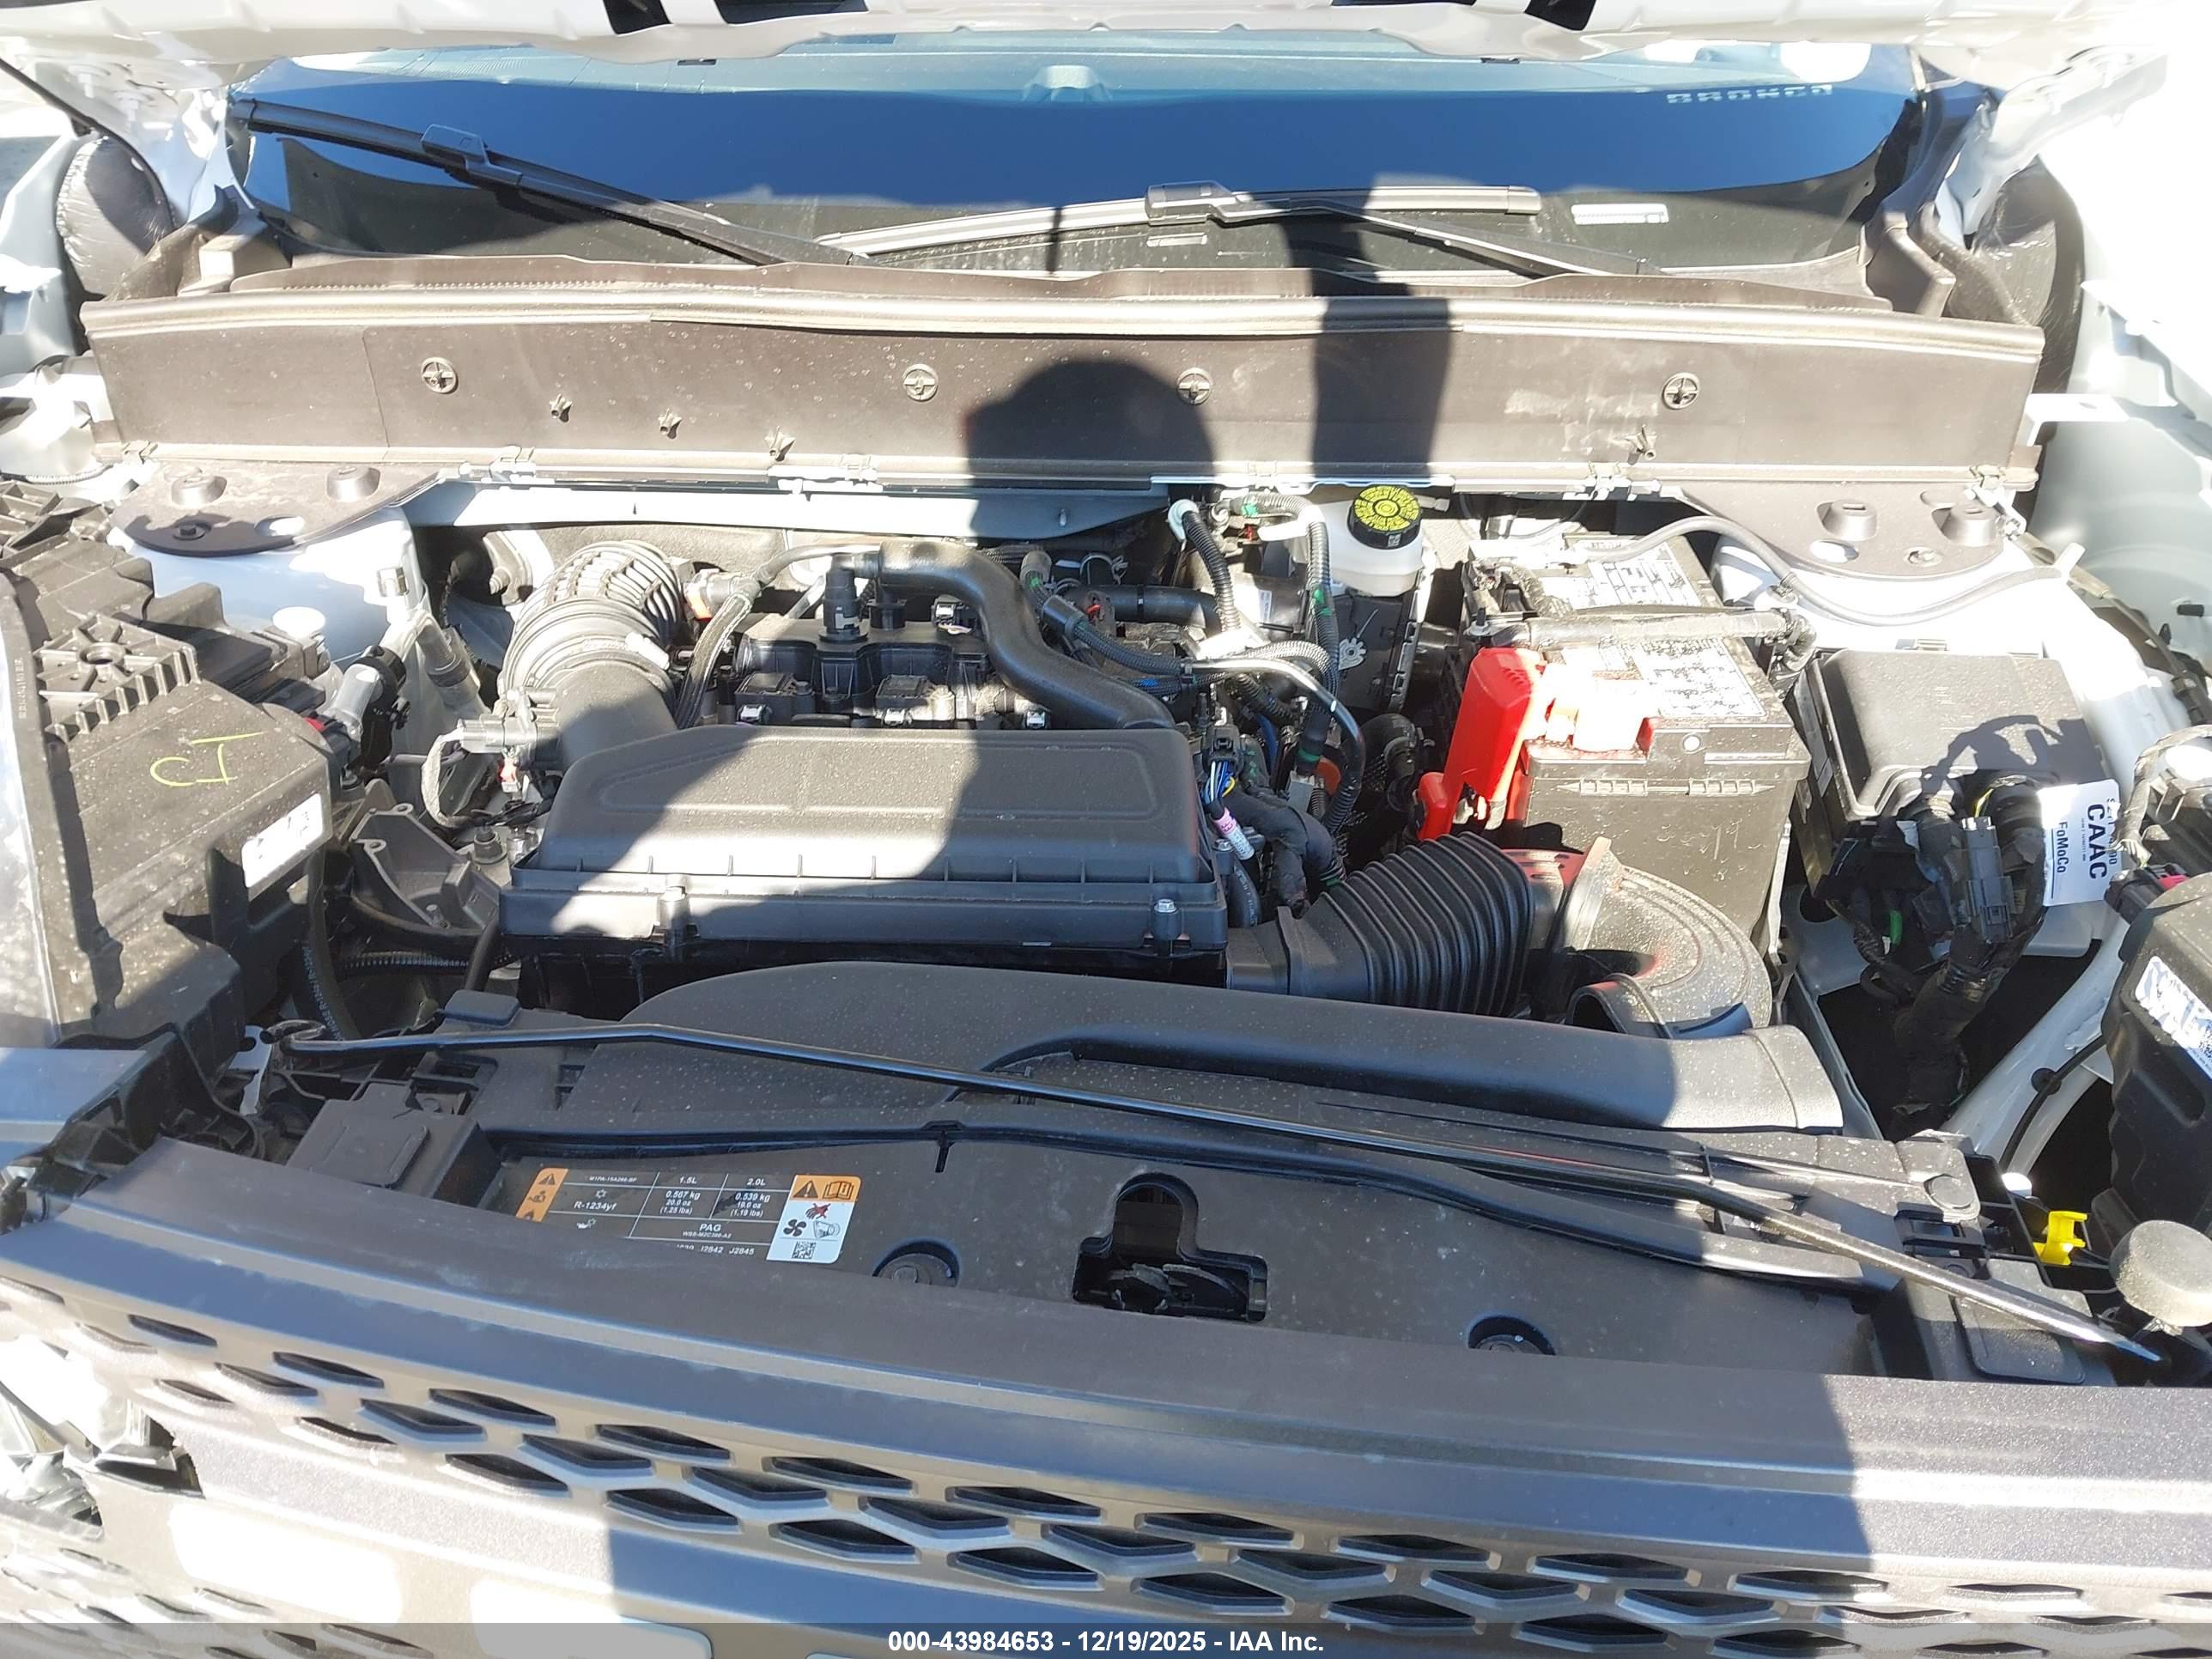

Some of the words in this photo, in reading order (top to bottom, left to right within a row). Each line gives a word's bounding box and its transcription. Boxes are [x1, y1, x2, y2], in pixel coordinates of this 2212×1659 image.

[2057, 821, 2069, 873] FoMoCo
[2087, 804, 2107, 879] CAAC
[746, 1177, 766, 1186] 2.0L
[690, 1191, 701, 1200] kg
[759, 1193, 771, 1203] kg
[574, 1200, 618, 1212] R-1234yf
